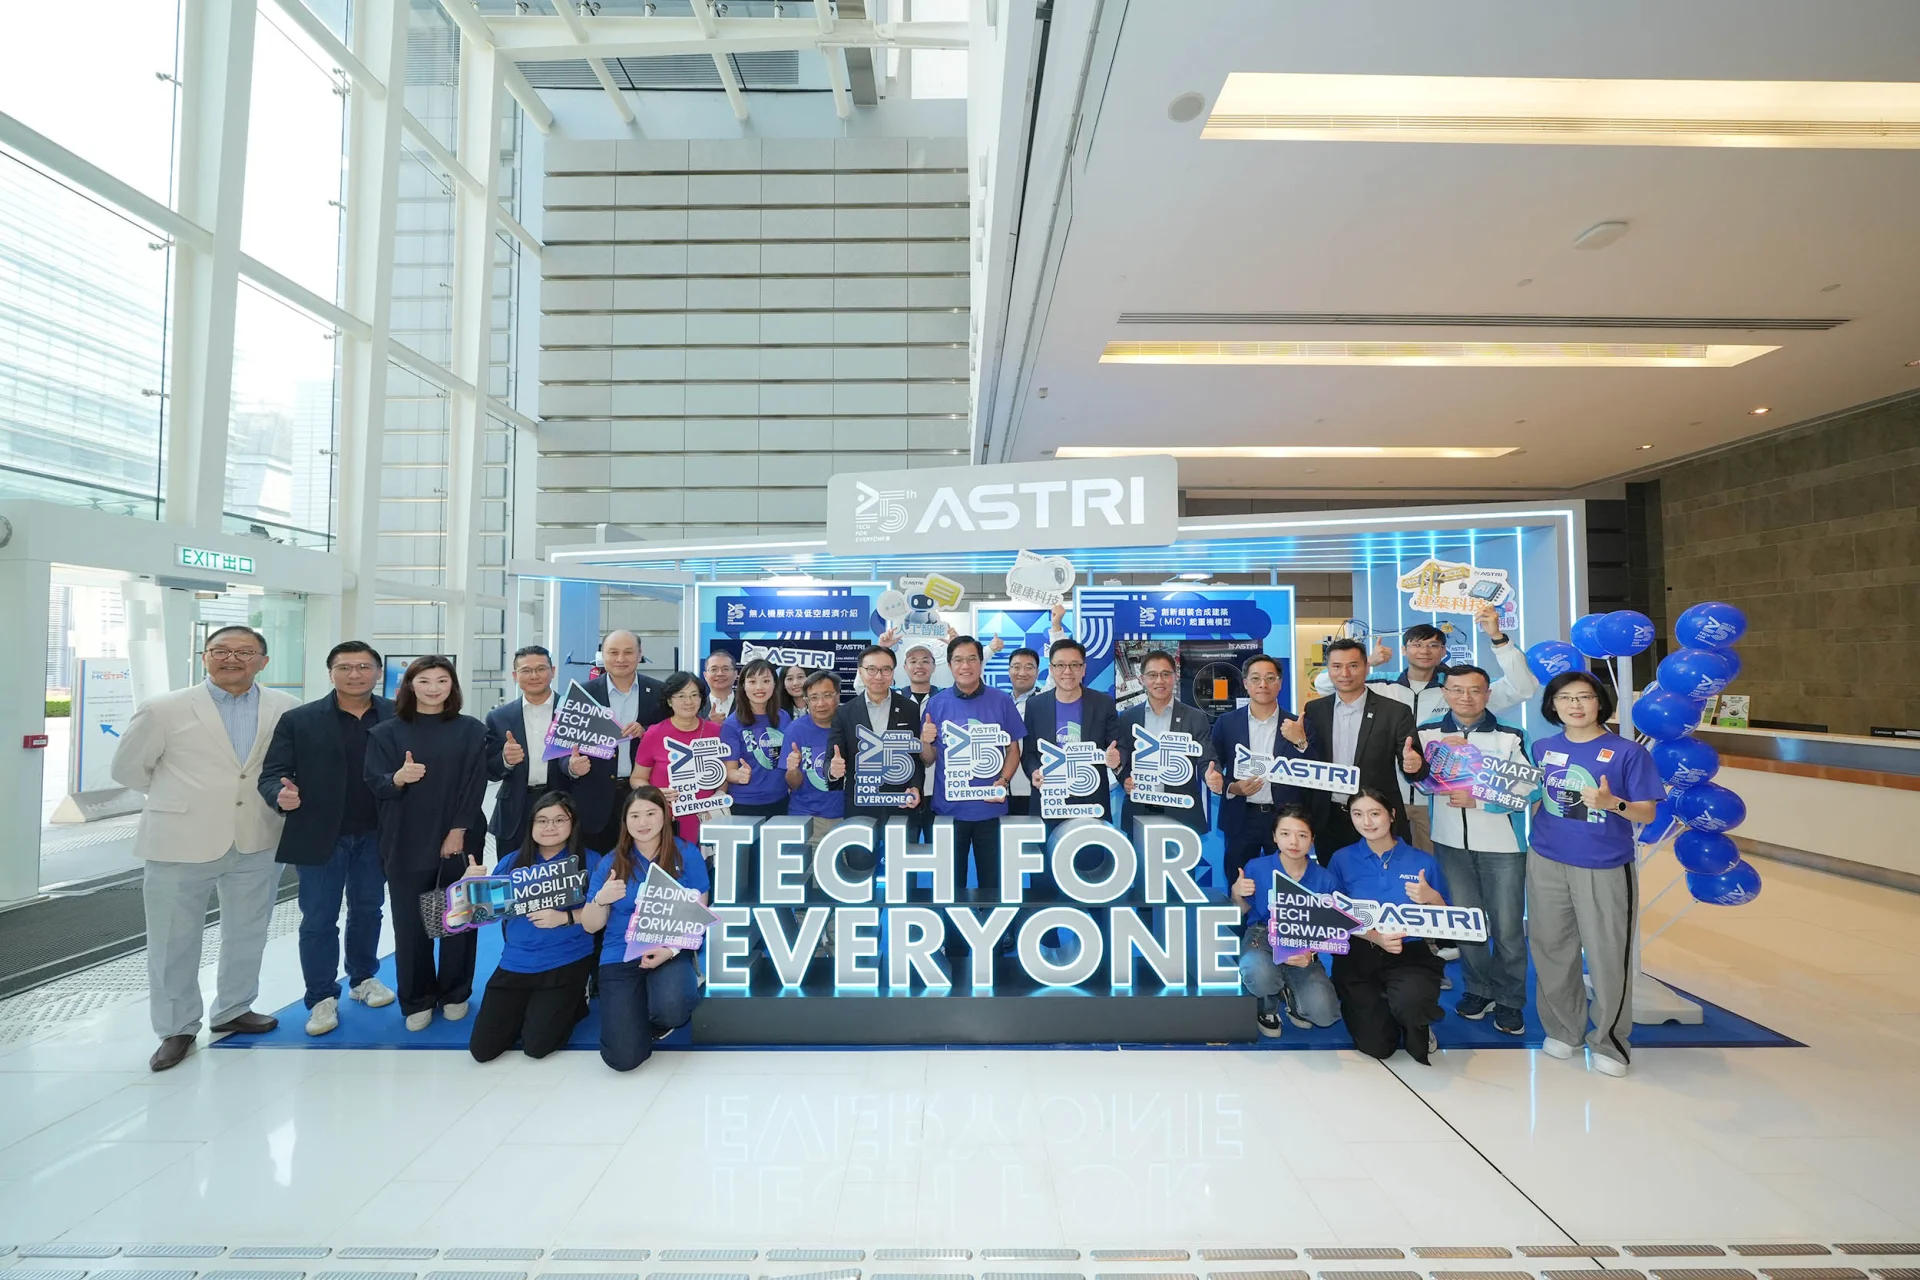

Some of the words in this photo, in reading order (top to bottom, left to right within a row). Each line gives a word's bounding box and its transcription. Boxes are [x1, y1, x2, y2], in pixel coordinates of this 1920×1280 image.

[914, 476, 1145, 533] ASTRI
[182, 548, 220, 568] EXIT
[223, 555, 252, 573] 出口
[1009, 581, 1061, 606] 健康科技
[1477, 585, 1491, 593] AI
[1416, 595, 1487, 611] 建築科技
[749, 608, 858, 618] 無人機展示及低空經濟介紹
[1161, 608, 1229, 616] 創新組裝合成建築
[896, 623, 946, 636] 人工智能
[1189, 617, 1231, 627] 起重機模型
[765, 649, 833, 668] ASTRI
[561, 699, 614, 719] LEADING
[556, 711, 590, 728] TECH
[549, 723, 617, 747] FORWARD
[1159, 734, 1189, 742] ASTRI
[691, 739, 719, 748] ASTRI
[947, 770, 971, 778] TECH
[1270, 760, 1356, 785] ASTRI
[1481, 757, 1542, 781] SMART
[857, 775, 882, 784] TECH
[947, 780, 966, 788] FOR
[1134, 774, 1158, 782] TECH
[1477, 771, 1515, 790] CITY
[675, 794, 693, 803] OR
[857, 795, 907, 804] EVERYONE
[948, 789, 996, 798] EVERYONE
[1043, 788, 1067, 796] TECH
[1133, 793, 1183, 805] EVERYONE
[1472, 784, 1526, 809] 智慧城市
[675, 798, 724, 813] EVERYONE
[1043, 798, 1062, 806] FOR
[1044, 807, 1093, 816] EVERYONE
[701, 822, 956, 904] TECH
[999, 822, 1210, 904] FOR
[511, 861, 568, 884] SMART
[513, 872, 588, 900] MOBILITY
[639, 885, 699, 903] LEADING
[514, 893, 567, 915] 智慧出行
[636, 900, 675, 916] TECH
[1272, 892, 1334, 909] LEADING
[1271, 907, 1310, 922] TECH
[1378, 906, 1481, 930] ASTRI
[630, 915, 704, 935] FORWARD
[1270, 921, 1348, 940] FORWARD
[704, 905, 1243, 988] EVERYONE
